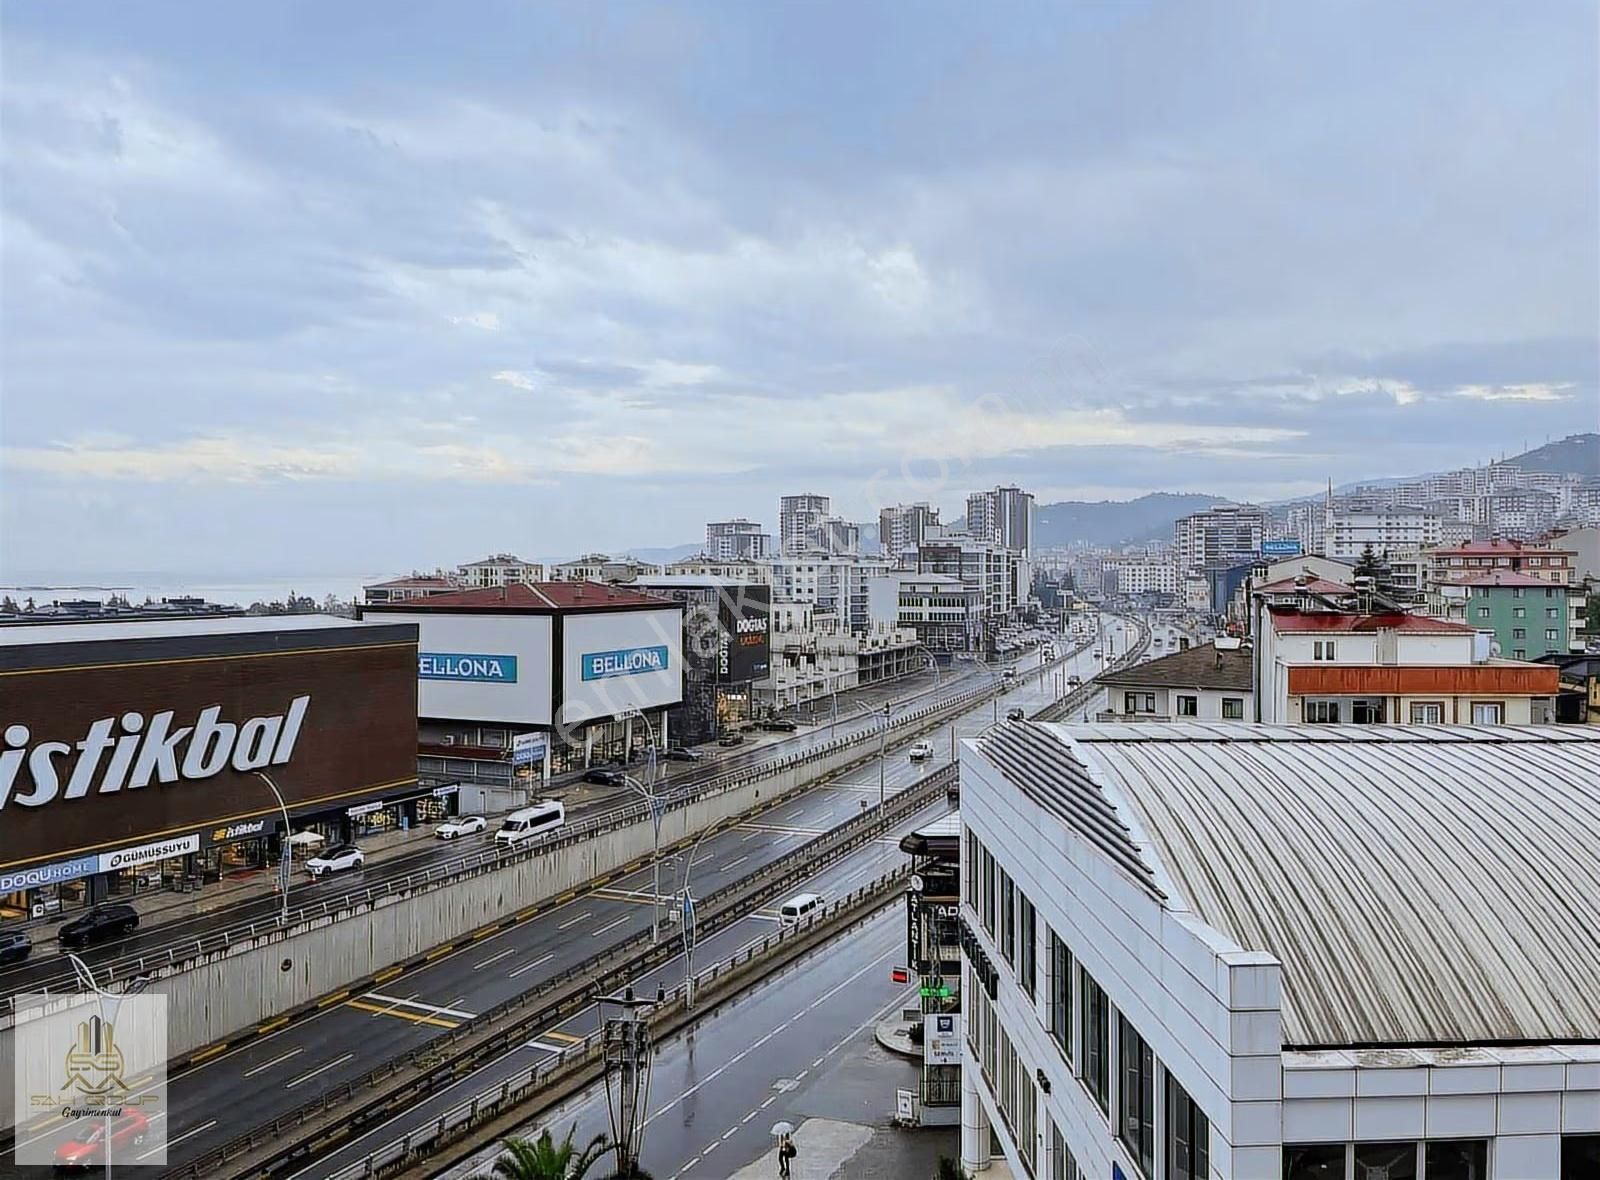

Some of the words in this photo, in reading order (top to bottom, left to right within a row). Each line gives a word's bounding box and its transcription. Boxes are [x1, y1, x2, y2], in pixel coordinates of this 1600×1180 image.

[417, 657, 503, 677] ELLONA
[592, 651, 661, 674] BELLONA
[0, 695, 311, 810] istikbal
[1, 868, 51, 890] DOQU
[53, 863, 89, 877] HOME
